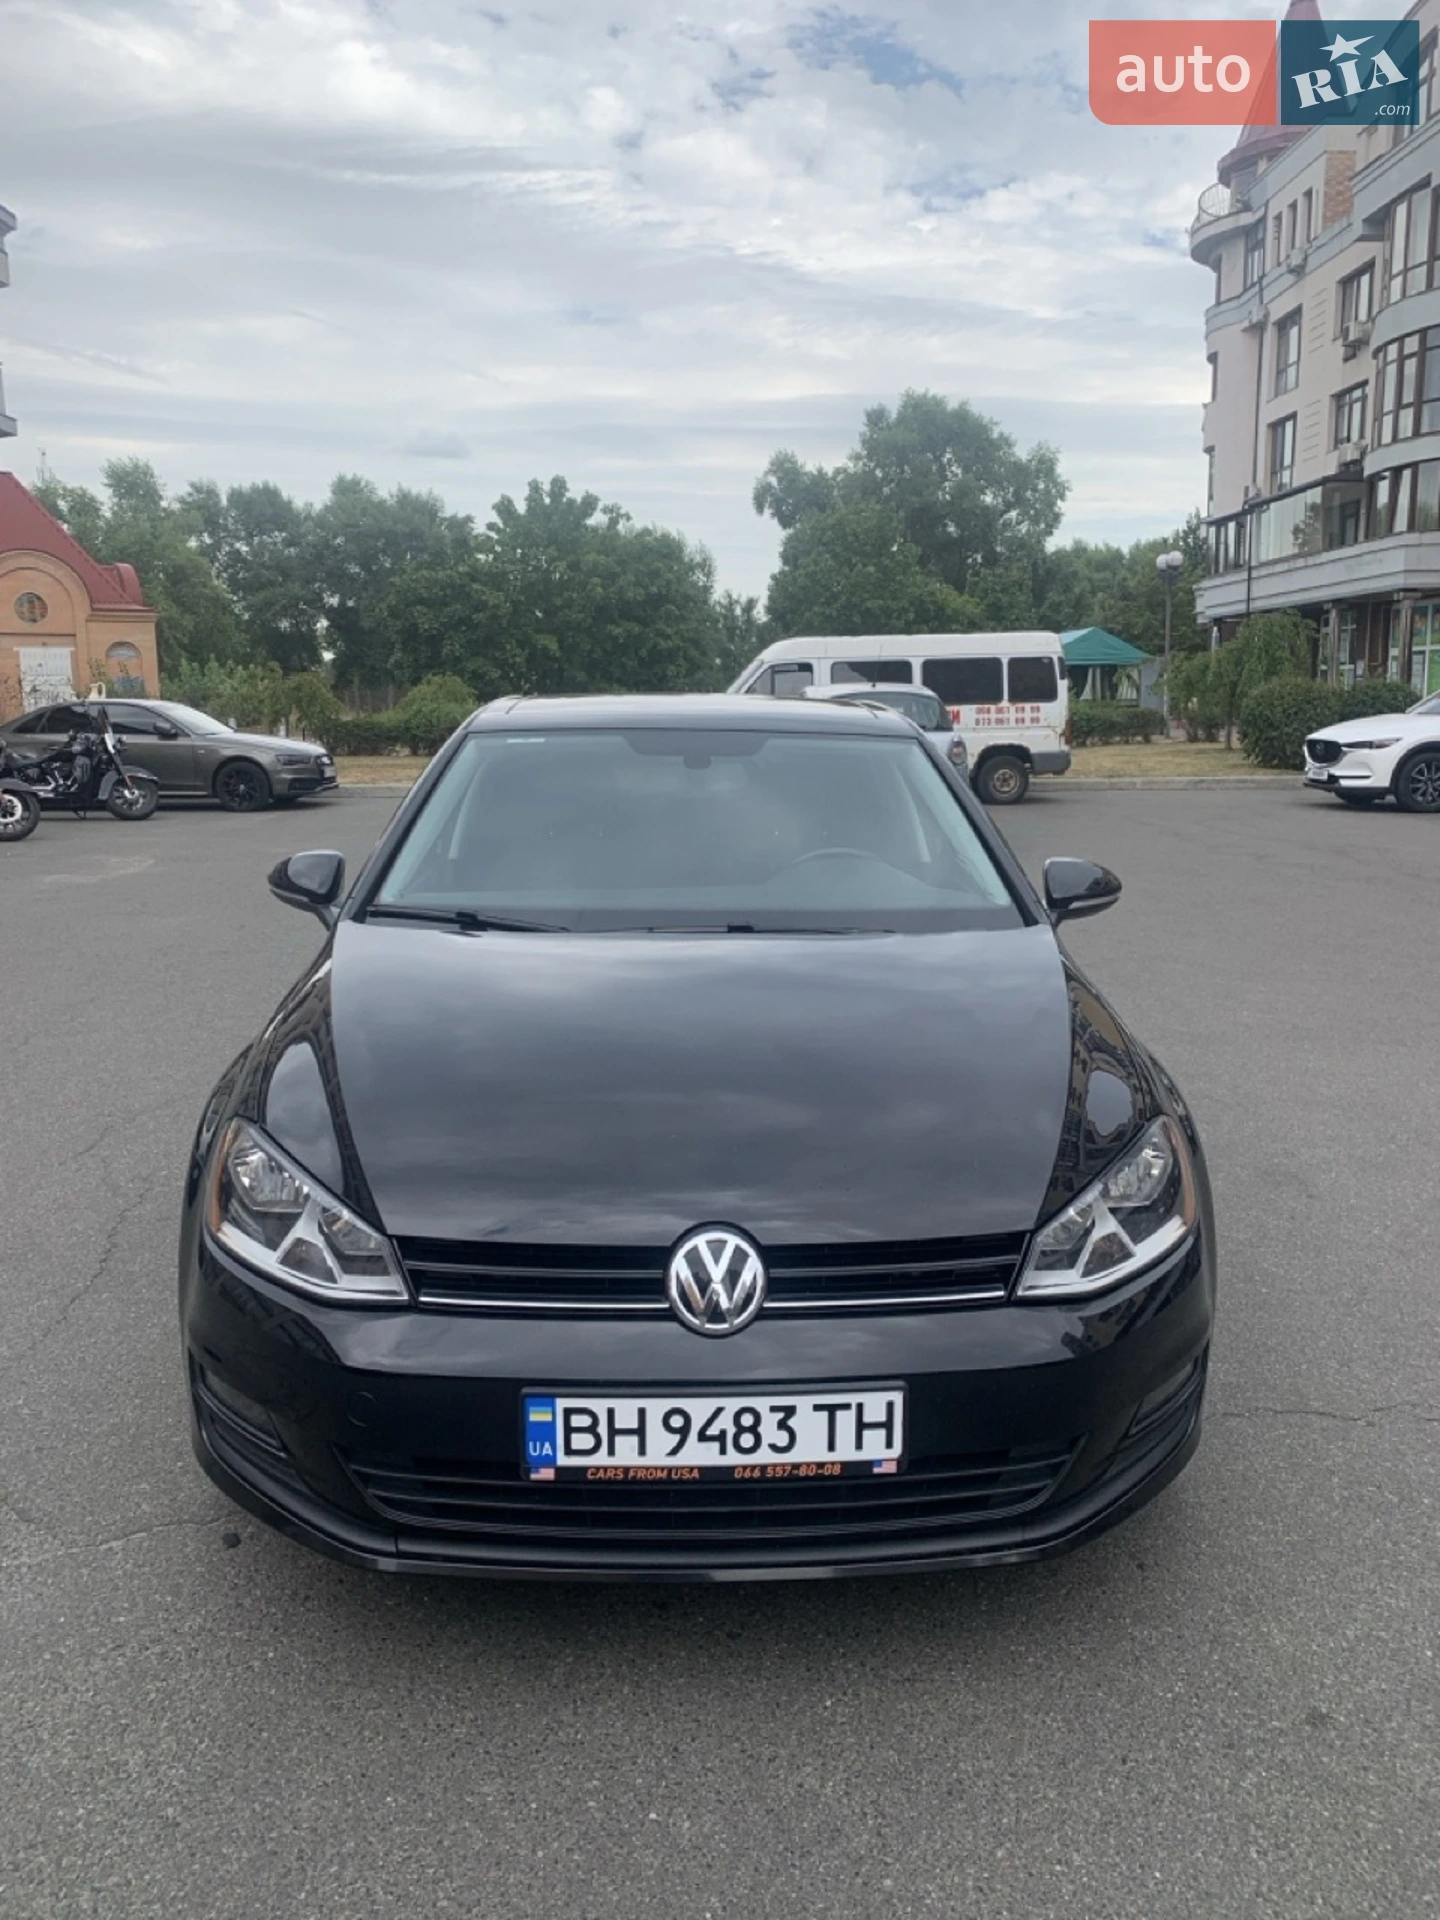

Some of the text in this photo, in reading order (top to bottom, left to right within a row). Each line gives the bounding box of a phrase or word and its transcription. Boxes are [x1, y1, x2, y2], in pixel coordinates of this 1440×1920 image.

[562, 1400, 895, 1458] BH 9483 TH
[529, 1441, 553, 1456] UA
[586, 1467, 624, 1479] CARS
[628, 1467, 668, 1480] FROM
[671, 1467, 700, 1479] USA
[734, 1465, 761, 1478] 066
